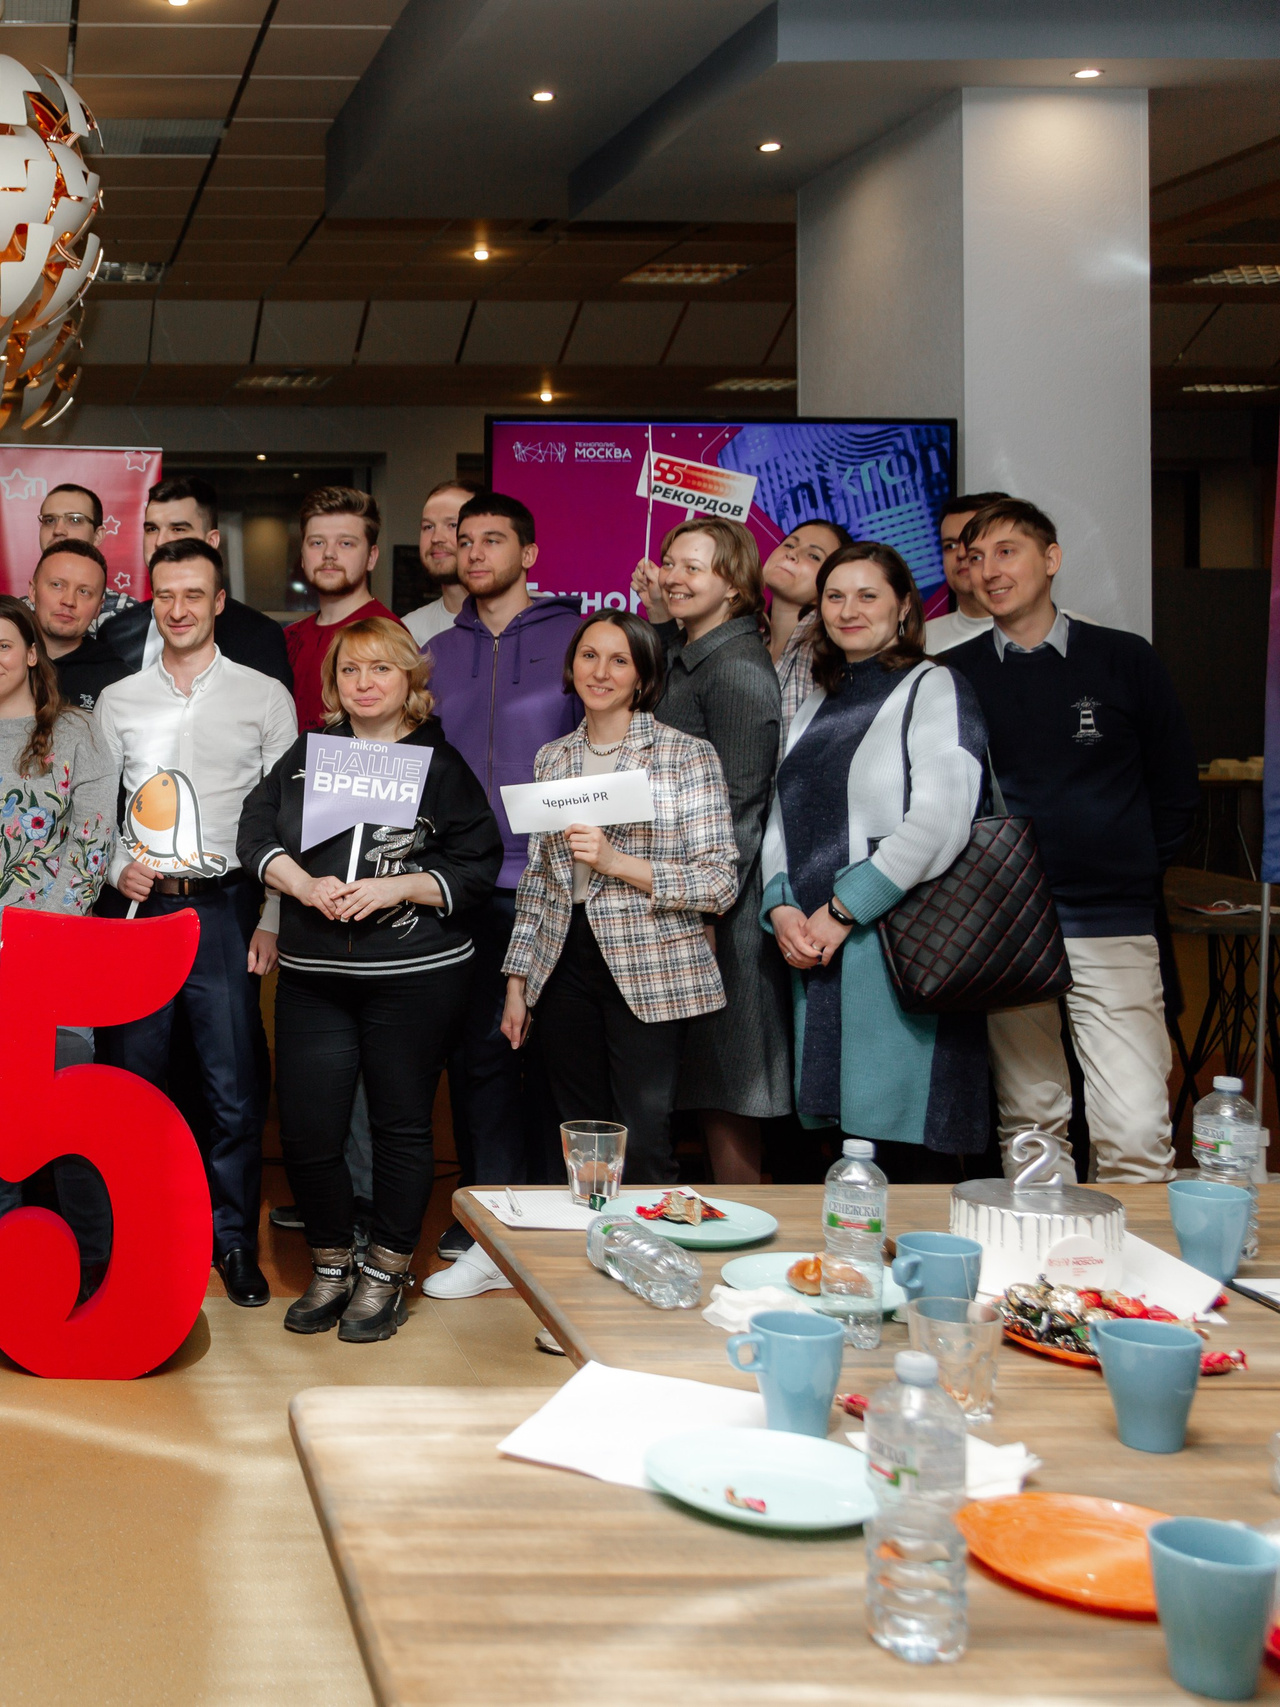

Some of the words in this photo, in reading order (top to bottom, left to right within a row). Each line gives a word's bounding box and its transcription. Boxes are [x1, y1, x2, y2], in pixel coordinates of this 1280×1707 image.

[574, 448, 633, 459] МОСКВА
[652, 484, 744, 517] РЕКОРДОВ
[350, 740, 388, 754] mikron
[316, 748, 423, 783] НАШЕ
[313, 771, 419, 804] ВРЕМЯ
[542, 793, 590, 809] Черный
[593, 791, 609, 801] PR
[1012, 1131, 1062, 1194] 2
[829, 1201, 880, 1218] СЕНЕЖСКАЯ
[1072, 1258, 1105, 1266] MOSCOW
